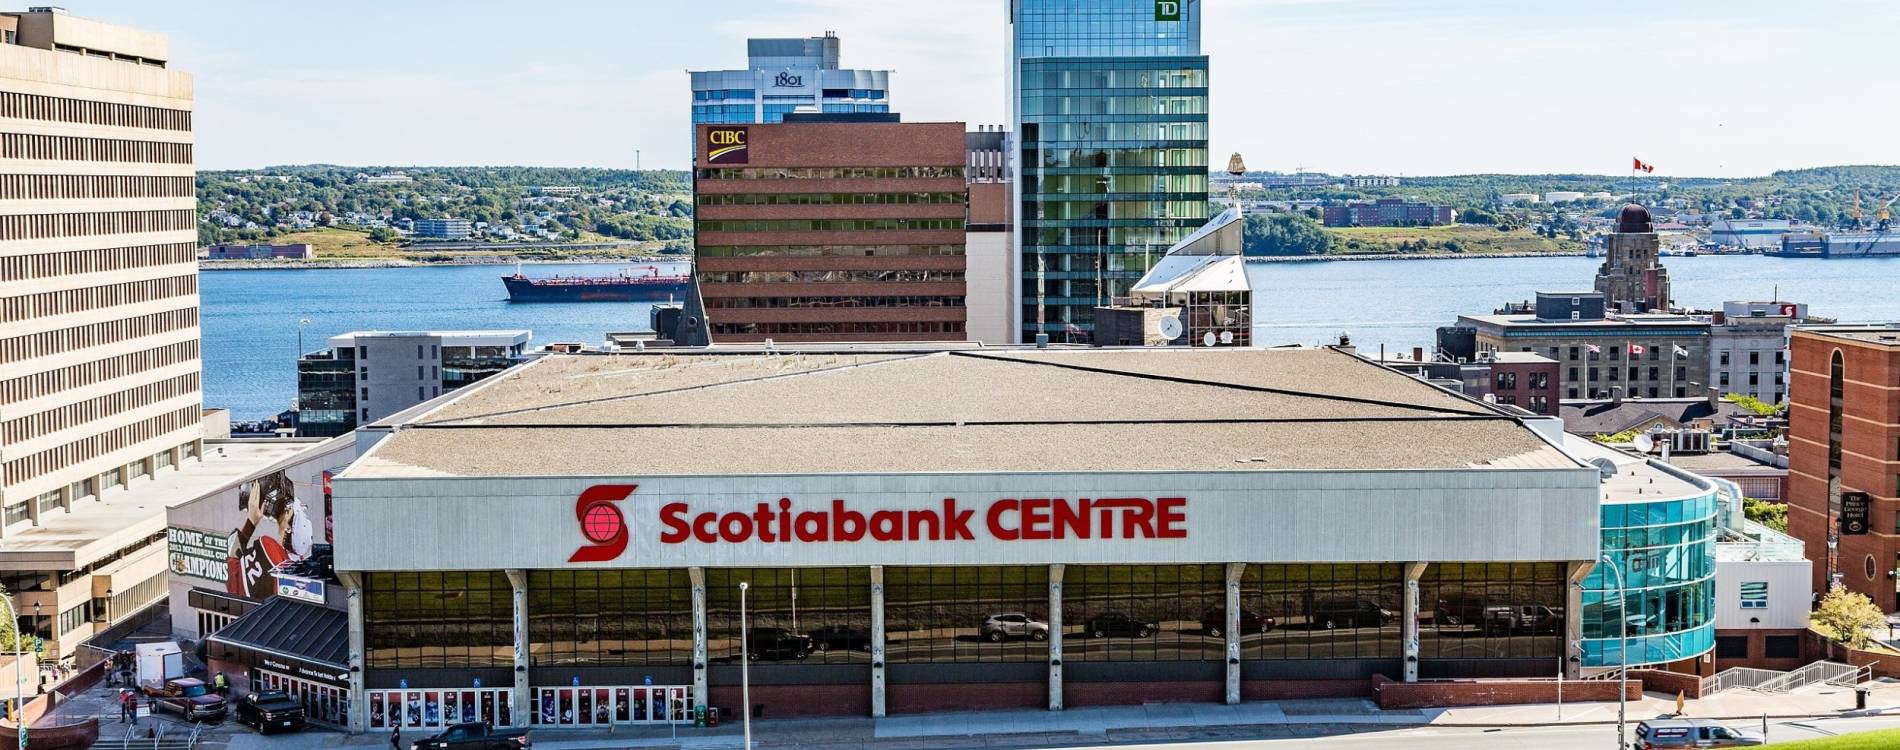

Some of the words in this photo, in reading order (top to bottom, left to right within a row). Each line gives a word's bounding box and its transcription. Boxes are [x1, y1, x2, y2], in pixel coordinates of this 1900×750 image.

[1157, 1, 1178, 15] TD
[775, 72, 802, 86] 1801
[710, 131, 745, 144] CIBC
[660, 498, 976, 544] Scotiabank
[986, 497, 1188, 541] CENTRE
[168, 528, 203, 547] HOME
[204, 535, 213, 544] OF
[213, 537, 228, 547] THE
[182, 545, 215, 558] MEMORIAL
[215, 551, 228, 560] CUP
